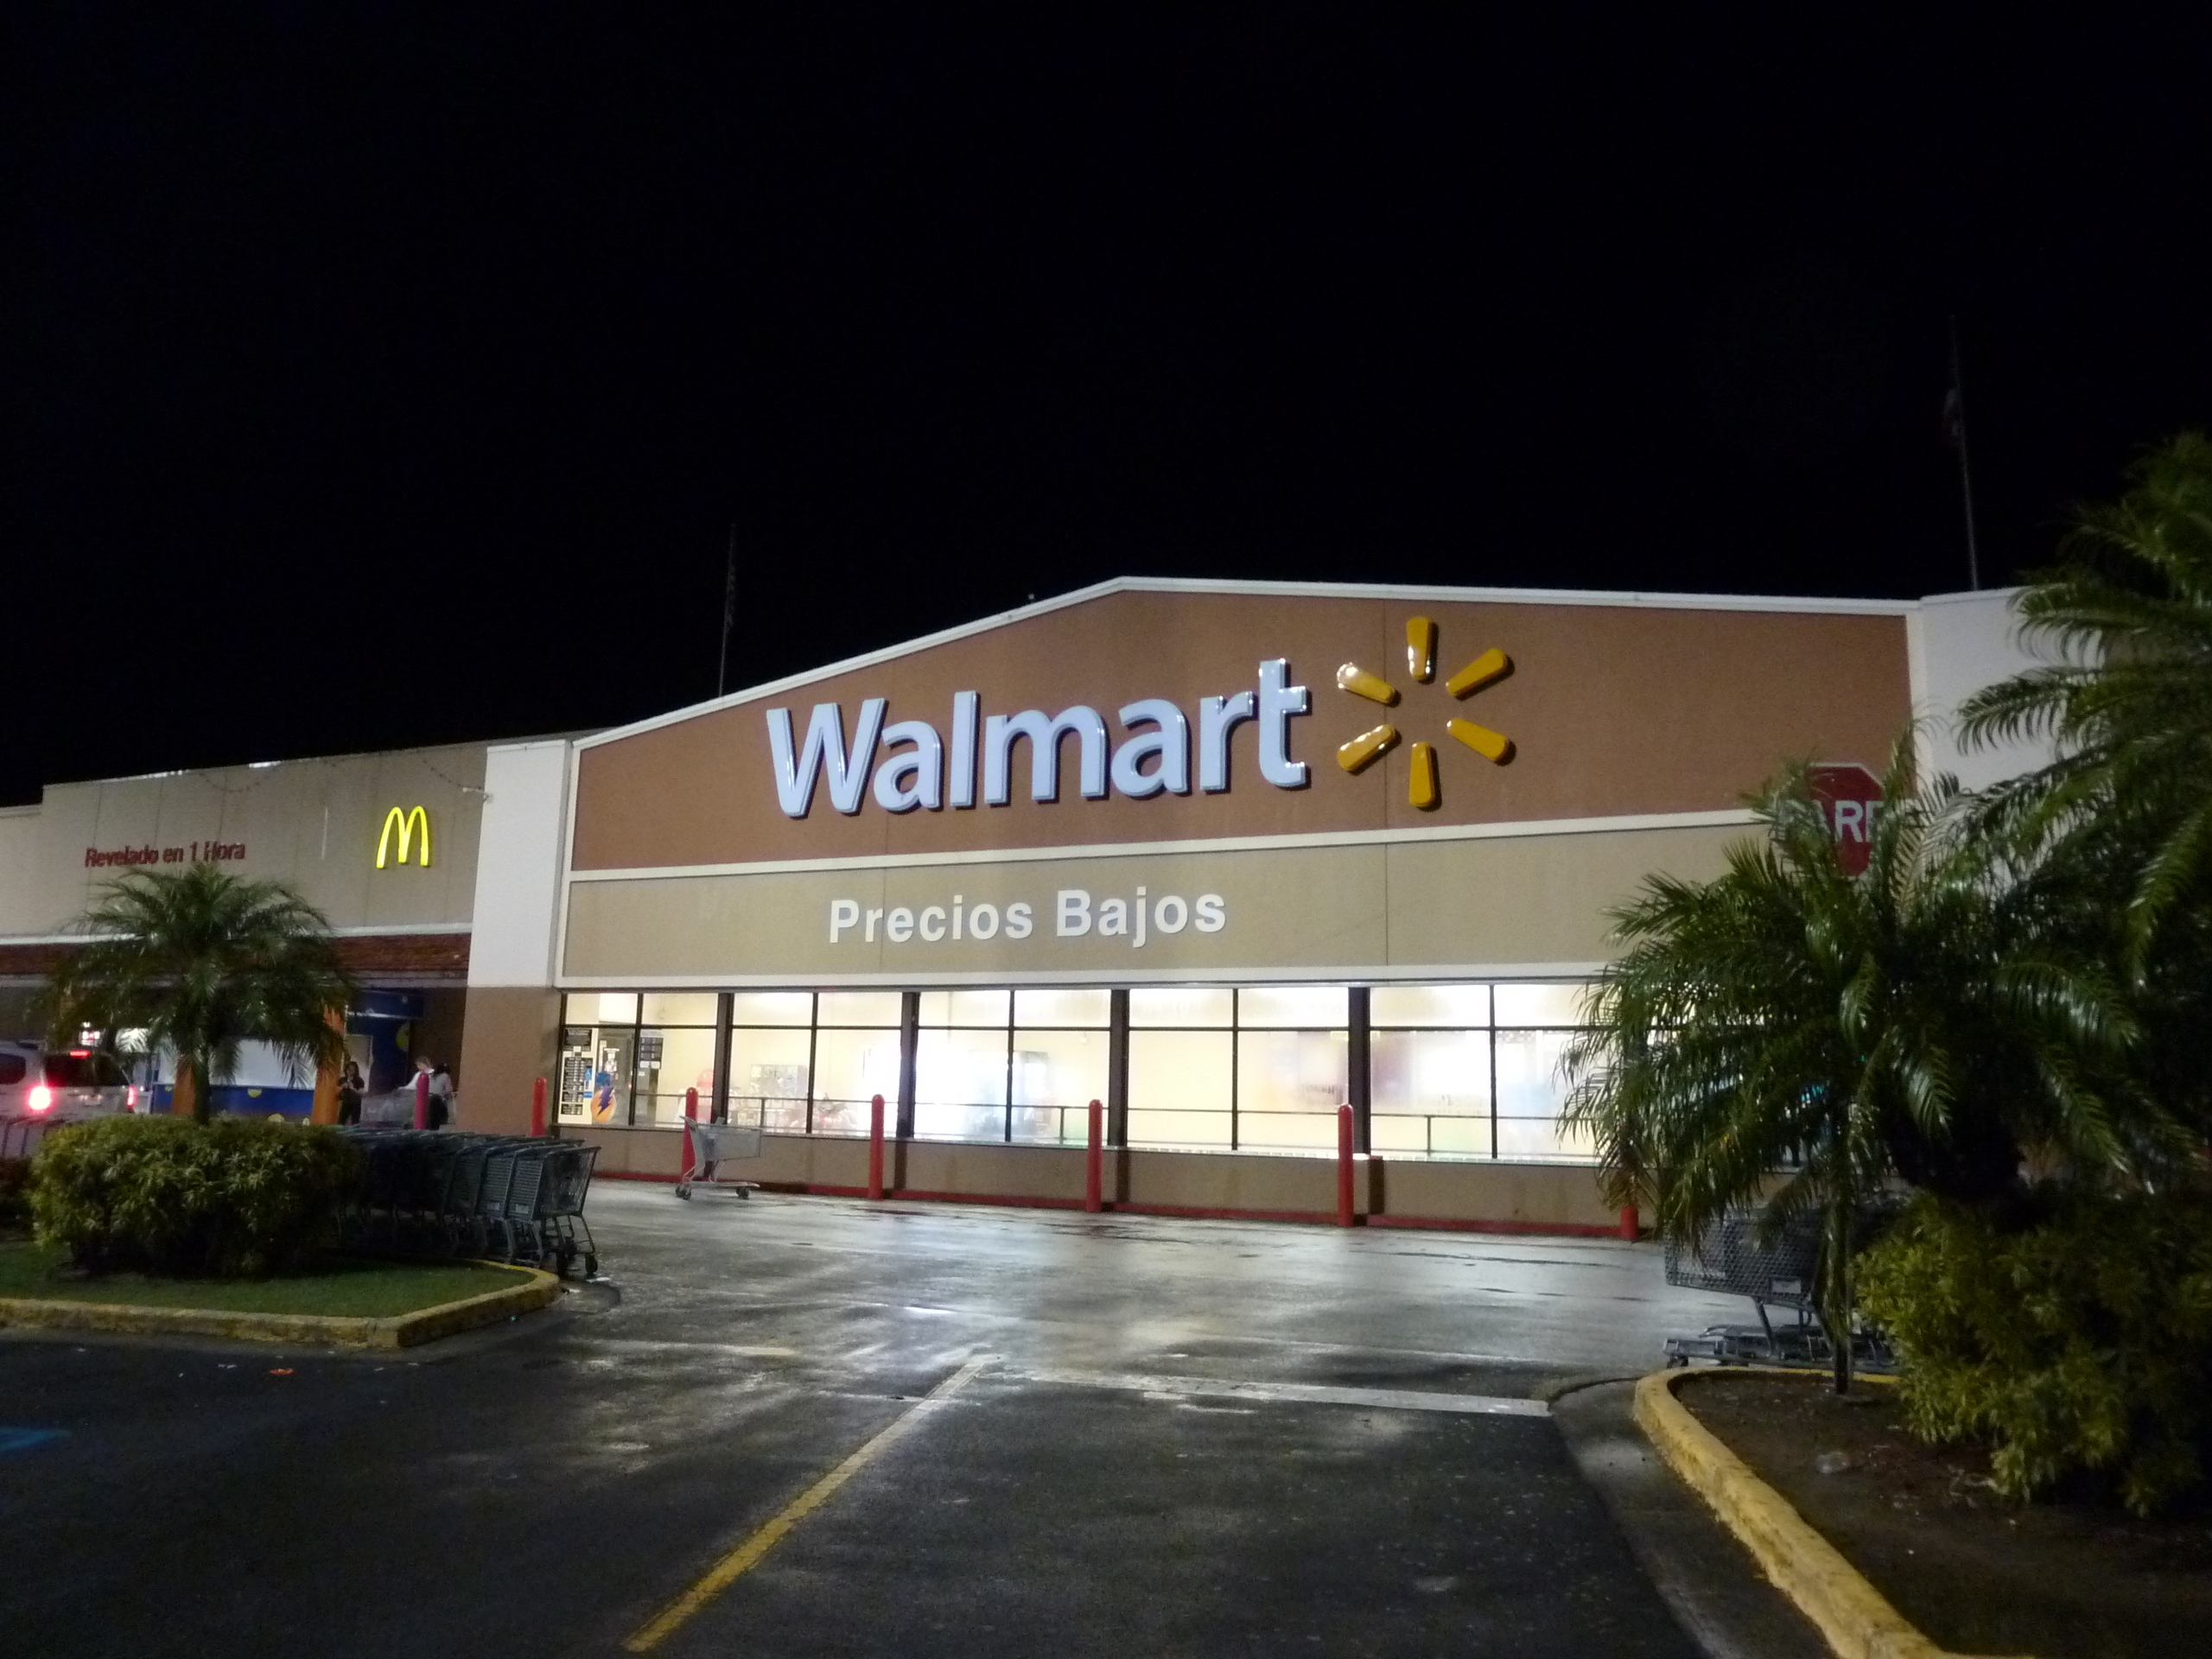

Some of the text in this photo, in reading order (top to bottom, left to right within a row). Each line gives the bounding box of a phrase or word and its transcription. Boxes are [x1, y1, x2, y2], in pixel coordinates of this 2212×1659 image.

[766, 658, 1307, 817] Walmart
[85, 840, 245, 868] Revelado en 1 Hora
[829, 886, 1226, 948] Precios Bajos
